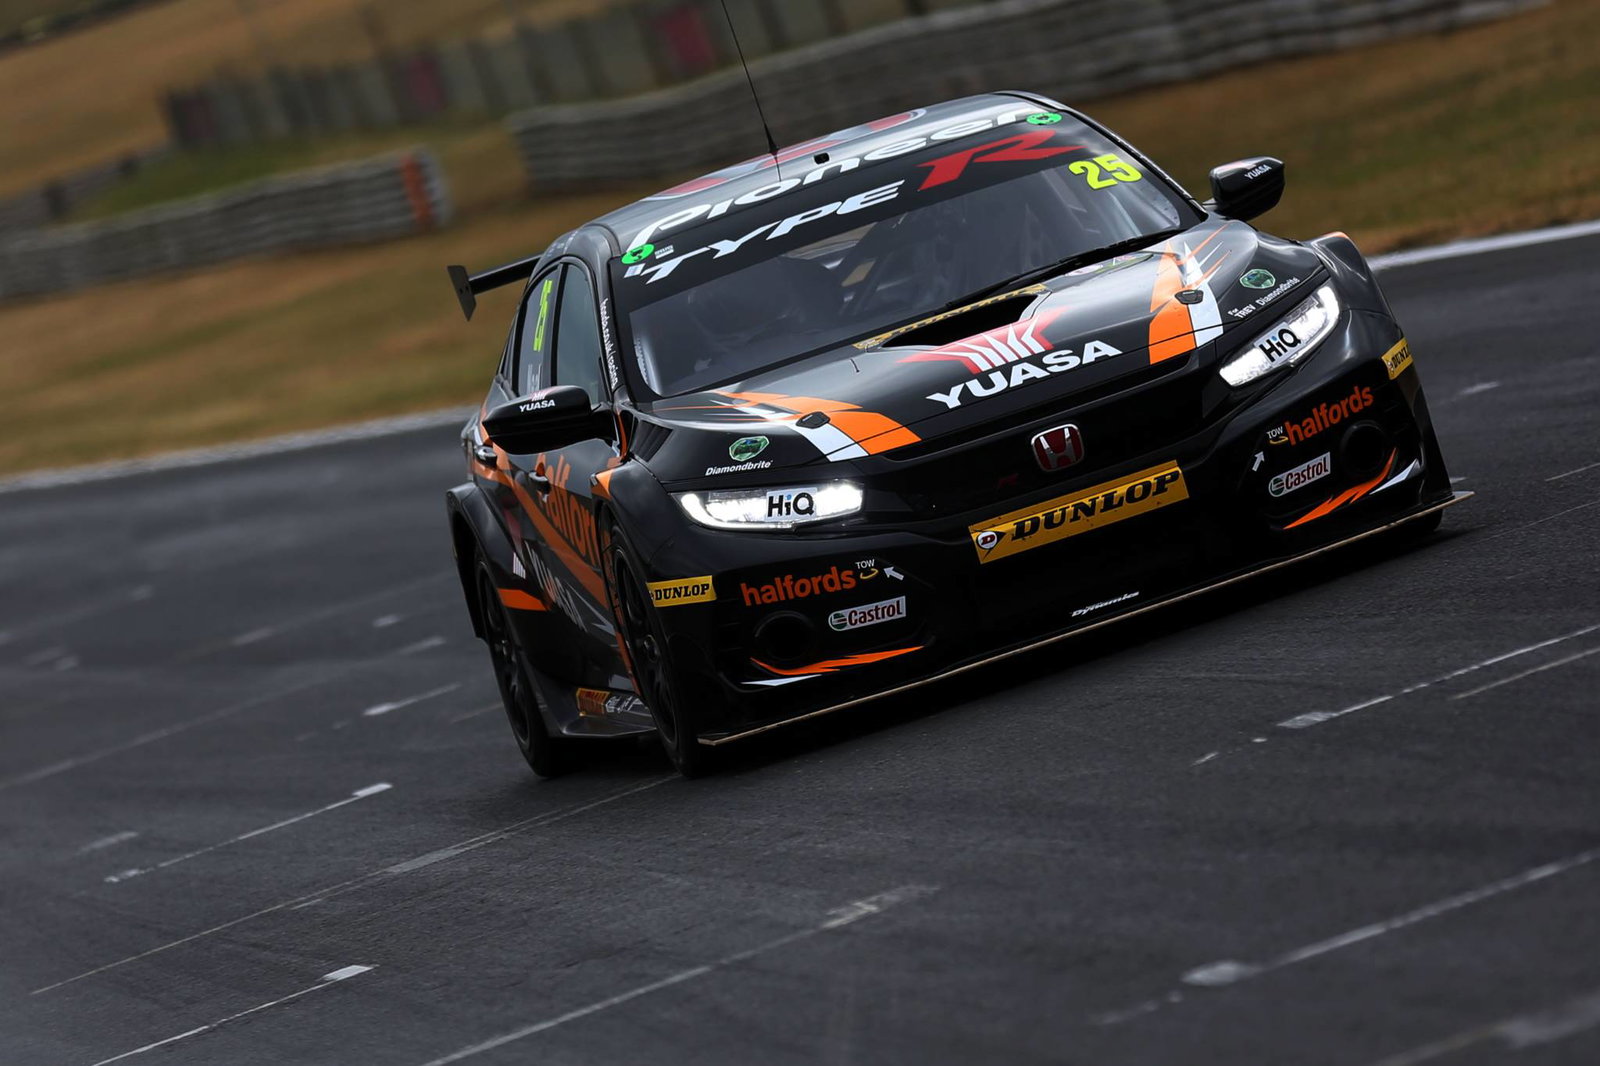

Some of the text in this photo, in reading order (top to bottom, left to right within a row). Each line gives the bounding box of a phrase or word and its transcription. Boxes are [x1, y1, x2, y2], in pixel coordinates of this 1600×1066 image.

[1068, 153, 1144, 190] 25
[1244, 164, 1272, 180] YUASA
[638, 130, 1089, 285] TYPE R
[1234, 304, 1256, 319] TREV
[1258, 327, 1302, 363] HiQ
[926, 340, 1123, 409] YUASA
[519, 399, 556, 412] YUASA
[1284, 385, 1374, 446] halfords
[1266, 426, 1284, 439] TOW
[1284, 457, 1329, 490] Castrol
[767, 492, 815, 517] HiQ
[1011, 470, 1181, 541] DUNLOP
[855, 559, 875, 569] TOW
[655, 583, 710, 600] DUNLOP
[740, 566, 857, 606] halfords
[848, 601, 903, 627] Castrol
